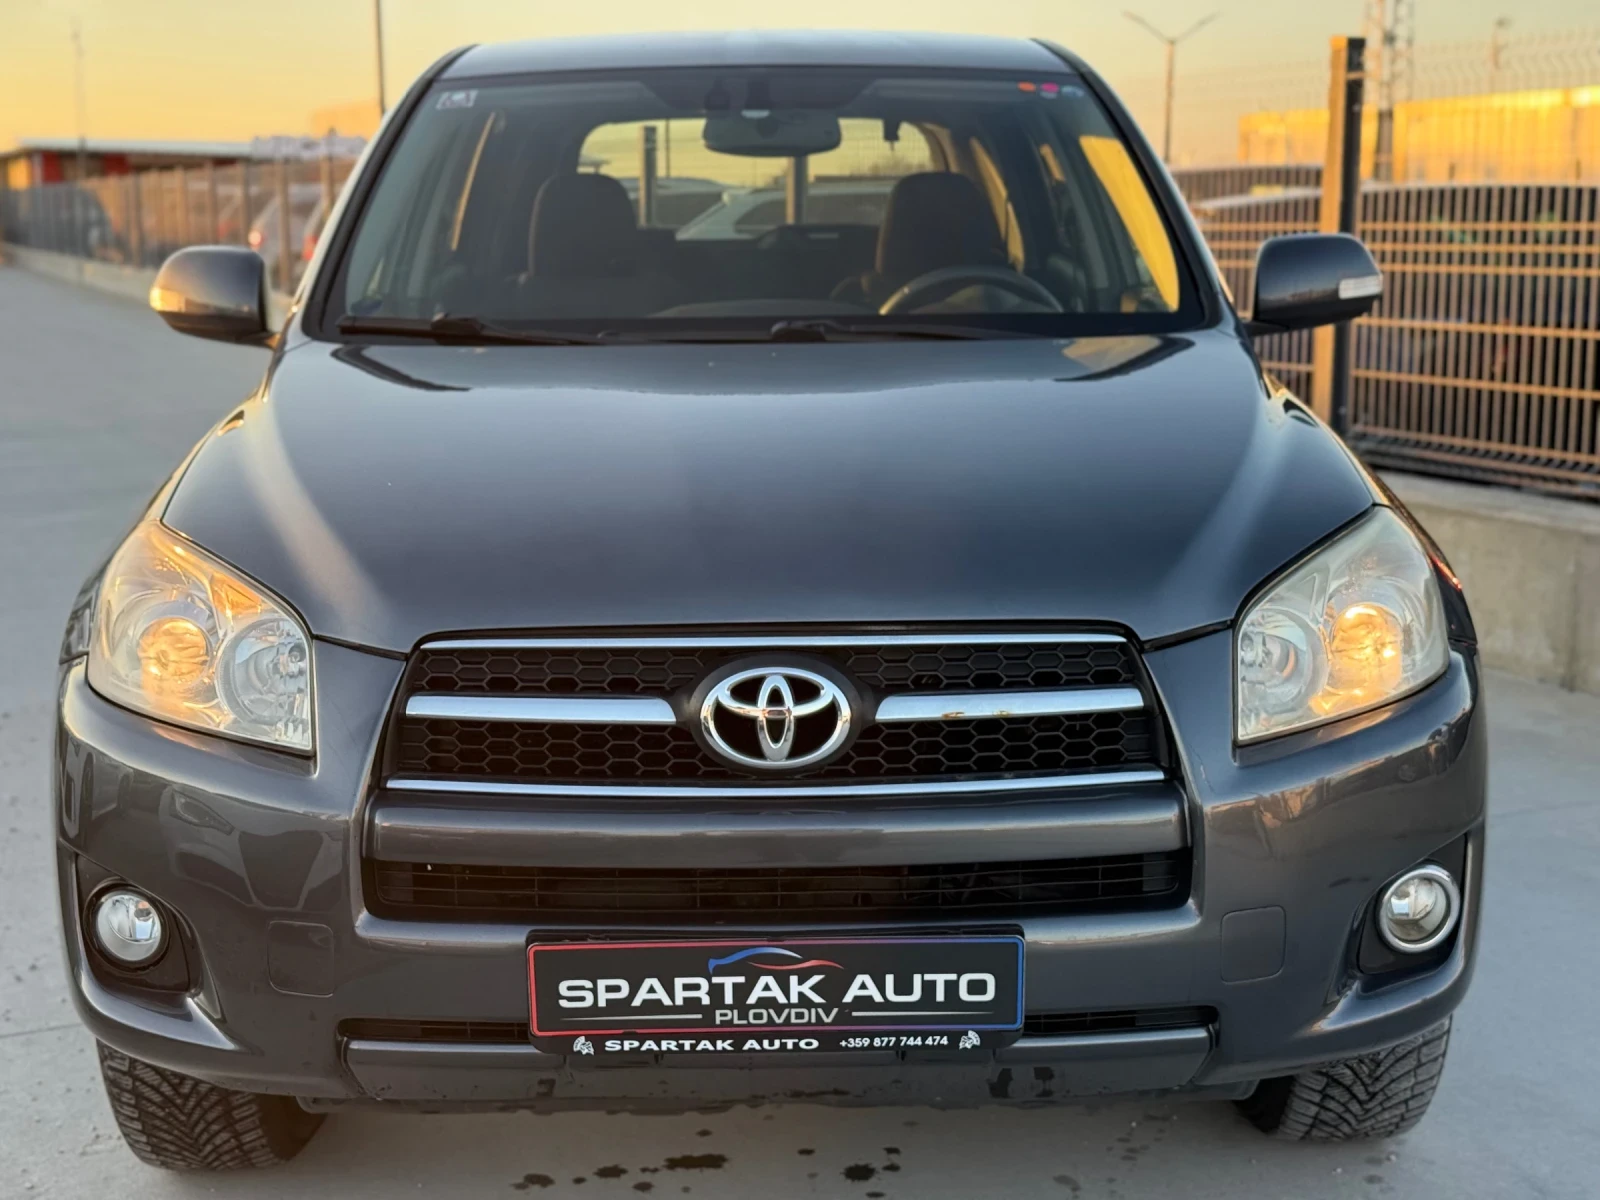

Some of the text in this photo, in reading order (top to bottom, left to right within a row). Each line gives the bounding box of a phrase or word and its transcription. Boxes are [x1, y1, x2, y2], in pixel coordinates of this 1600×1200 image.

[558, 972, 996, 1009] SPARTAK AUTO
[715, 1007, 839, 1025] PLOVDIV
[604, 1038, 820, 1052] SPARTAK AUTO
[839, 1035, 949, 1048] +359 877 744 474
